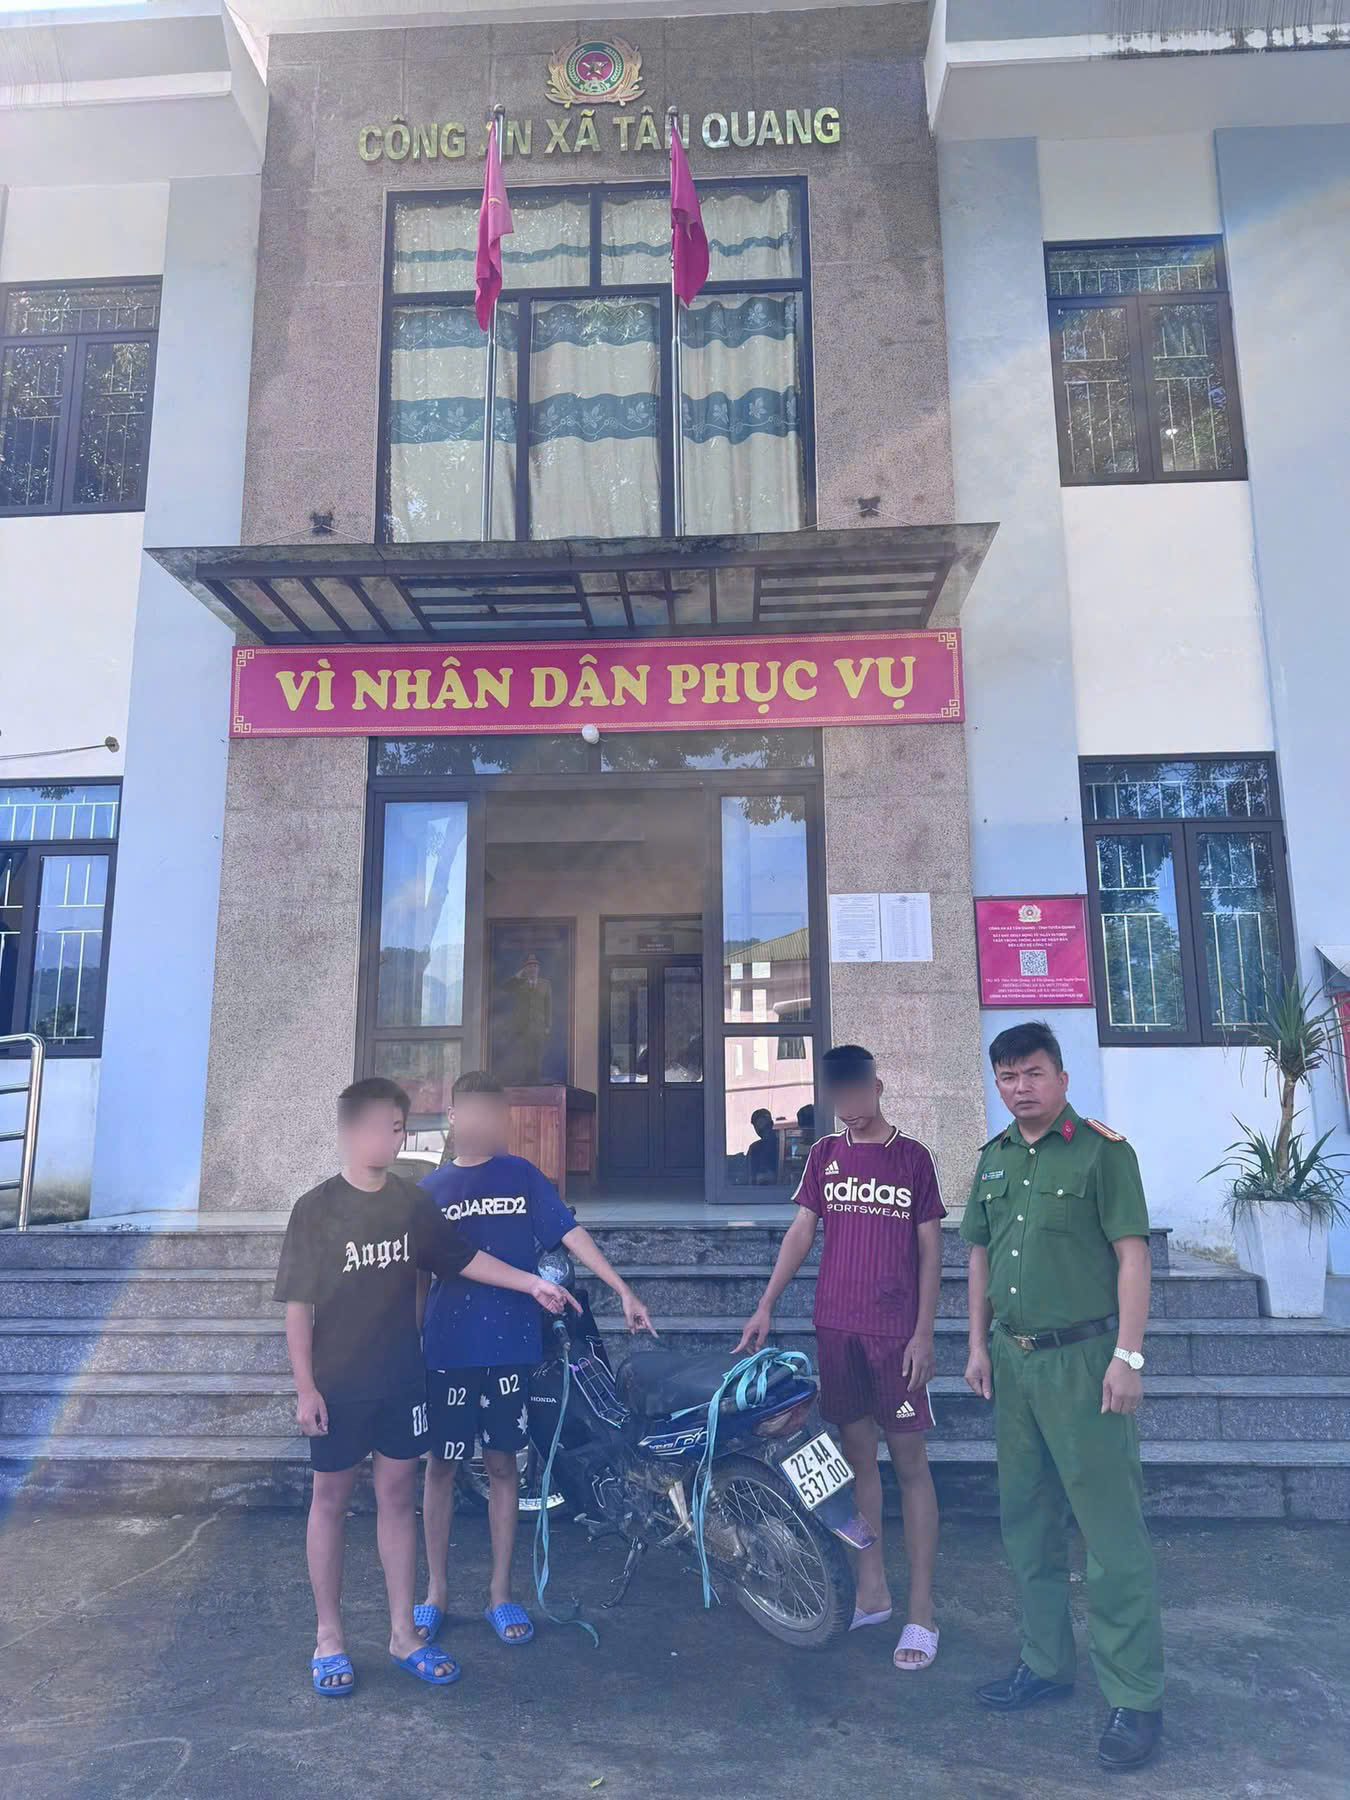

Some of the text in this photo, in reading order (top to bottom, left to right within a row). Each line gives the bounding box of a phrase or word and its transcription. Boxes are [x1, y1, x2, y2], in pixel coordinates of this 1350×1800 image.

[358, 105, 841, 162] CÔNG N XÃ TÂN QUANG
[275, 653, 917, 714] VÌ NHÂN DÂN PHỤC VỤ
[824, 1177, 912, 1207] adidas
[342, 1231, 410, 1273] Angel
[447, 1387, 467, 1406] D2
[499, 1374, 520, 1396] D2
[530, 1396, 557, 1404] HONDA
[444, 1441, 465, 1460] D2
[799, 1458, 849, 1505] 537.00
